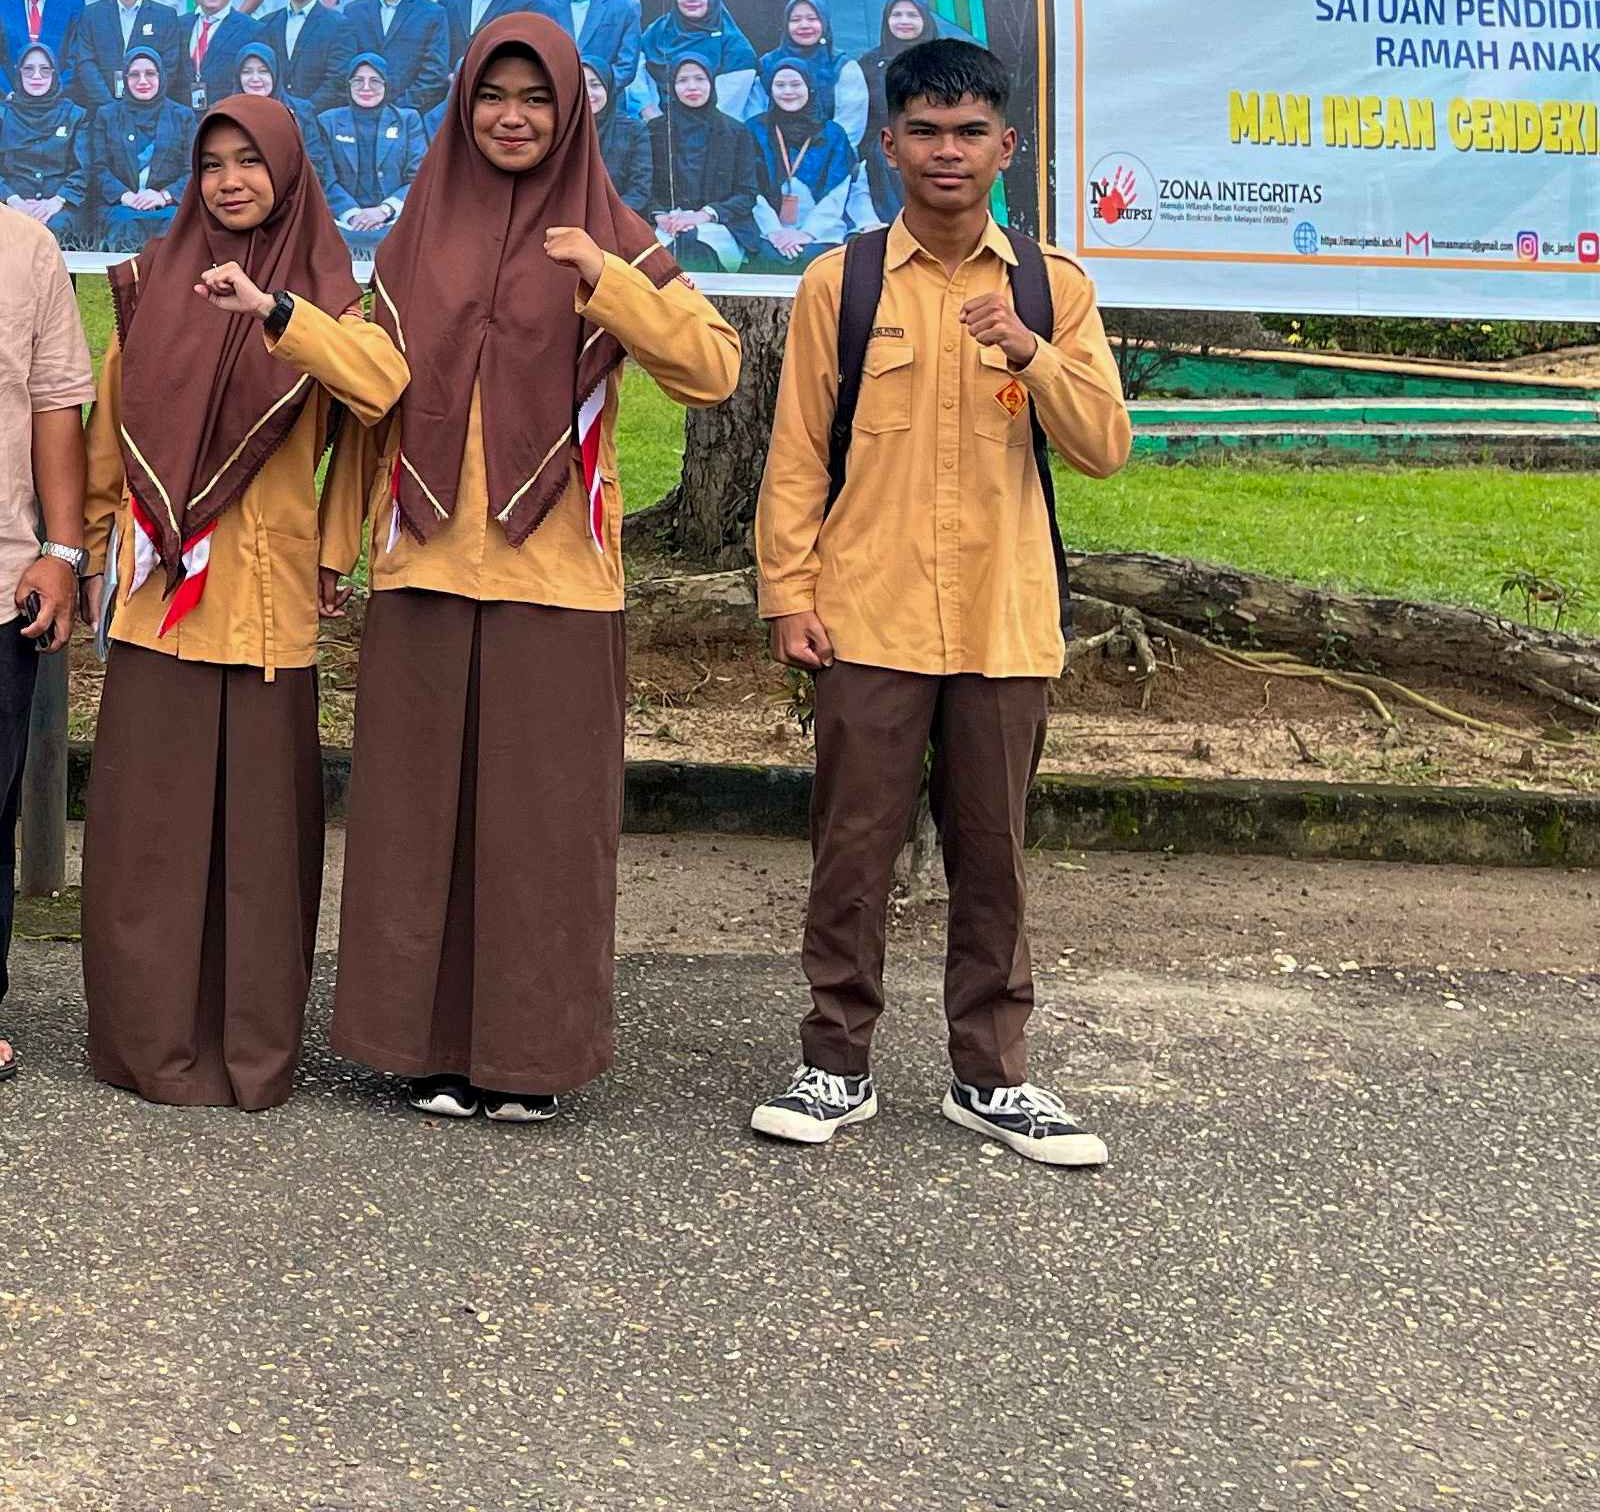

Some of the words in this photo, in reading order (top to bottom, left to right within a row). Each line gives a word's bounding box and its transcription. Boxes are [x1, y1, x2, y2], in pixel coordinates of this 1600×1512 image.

[1376, 37, 1498, 69] RAMAH
[1228, 91, 1311, 146] MAN
[1322, 95, 1436, 150] INSAN
[1160, 180, 1212, 200] ZONA
[1218, 182, 1321, 203] INTEGRITAS
